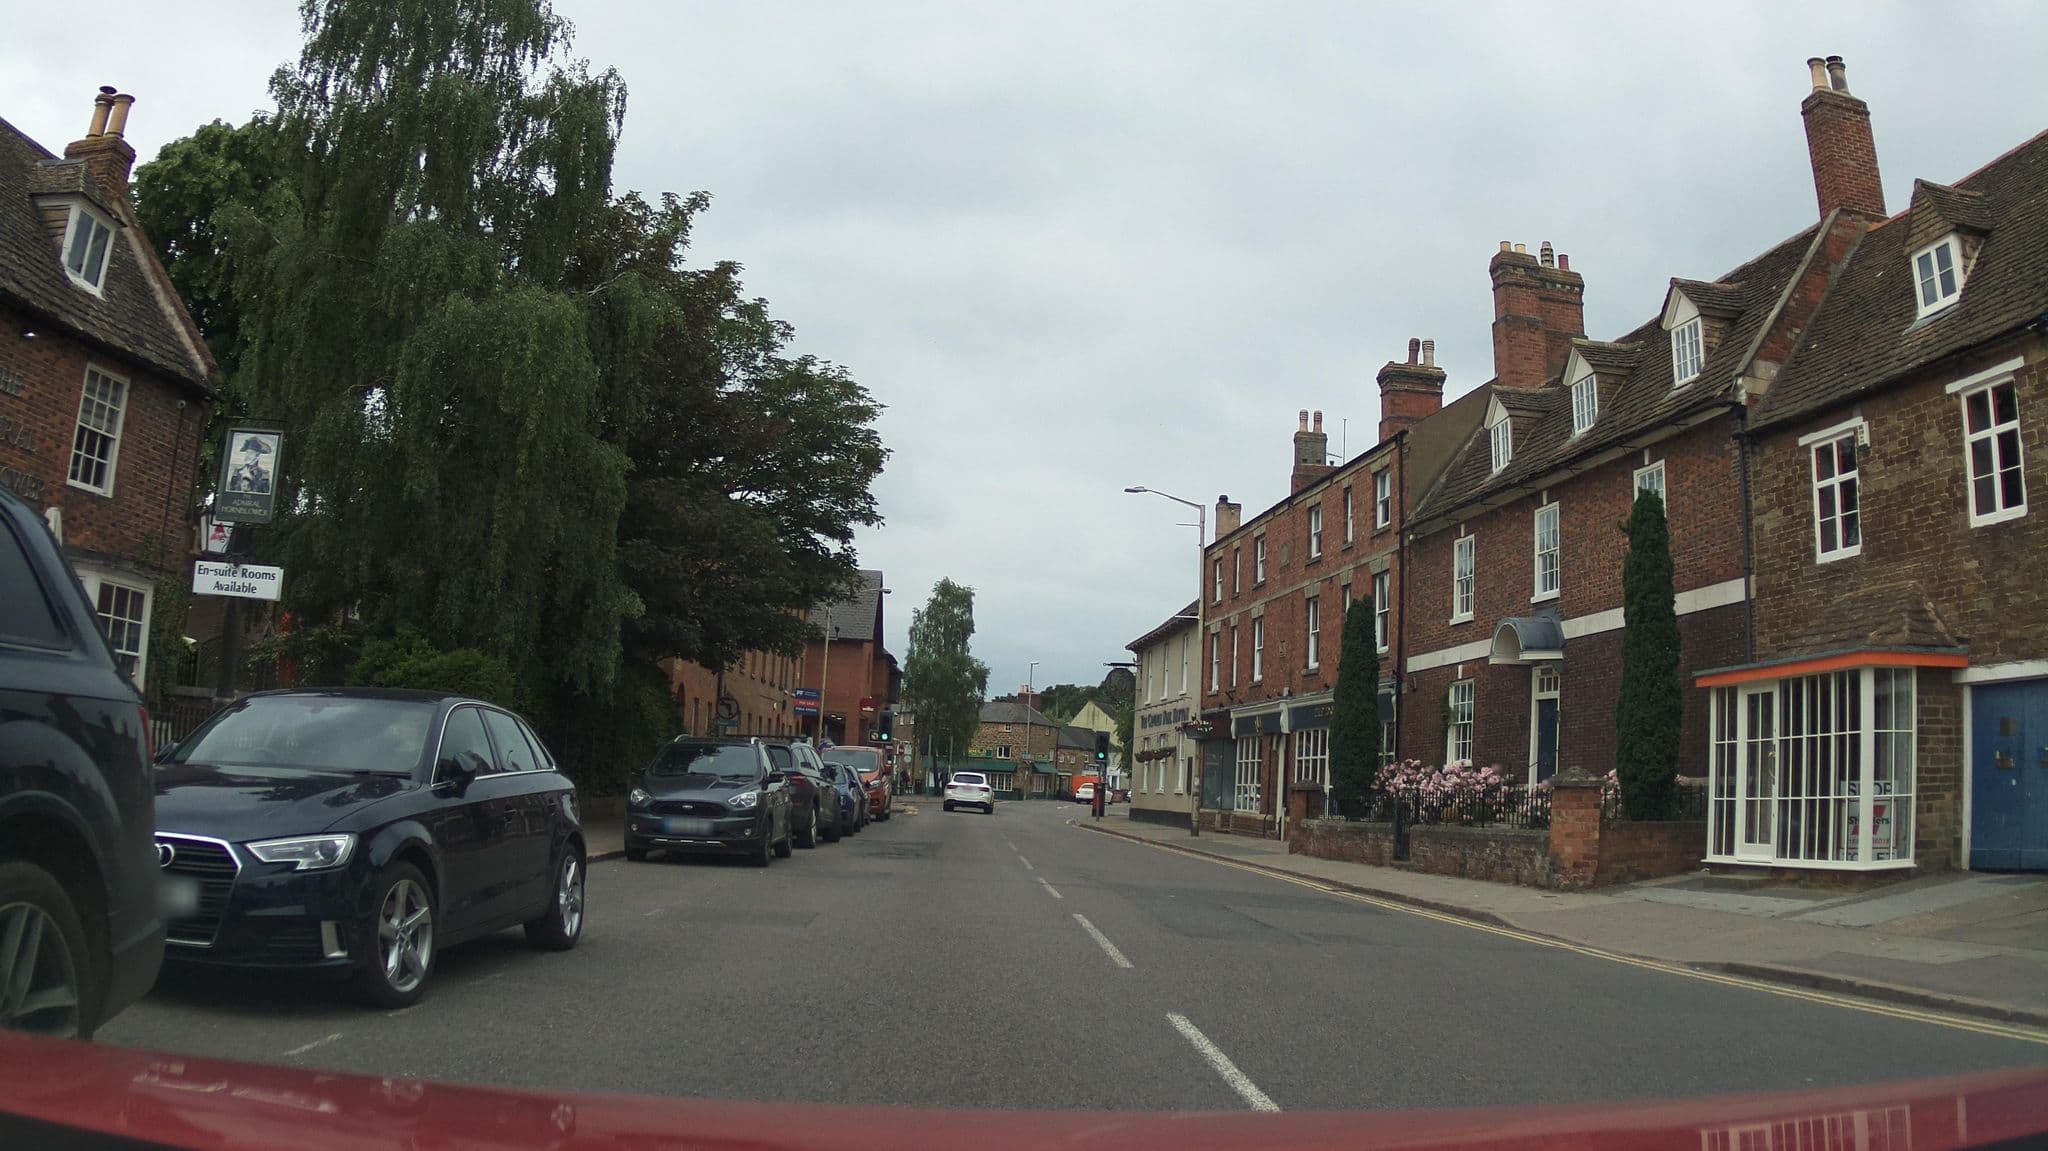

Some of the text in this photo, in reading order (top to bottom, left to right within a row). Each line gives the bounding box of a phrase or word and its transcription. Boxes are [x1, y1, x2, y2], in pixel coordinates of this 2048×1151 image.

[197, 564, 276, 581] En-suite Rooms
[212, 581, 257, 594] Available
[1848, 782, 1892, 796] SOP
